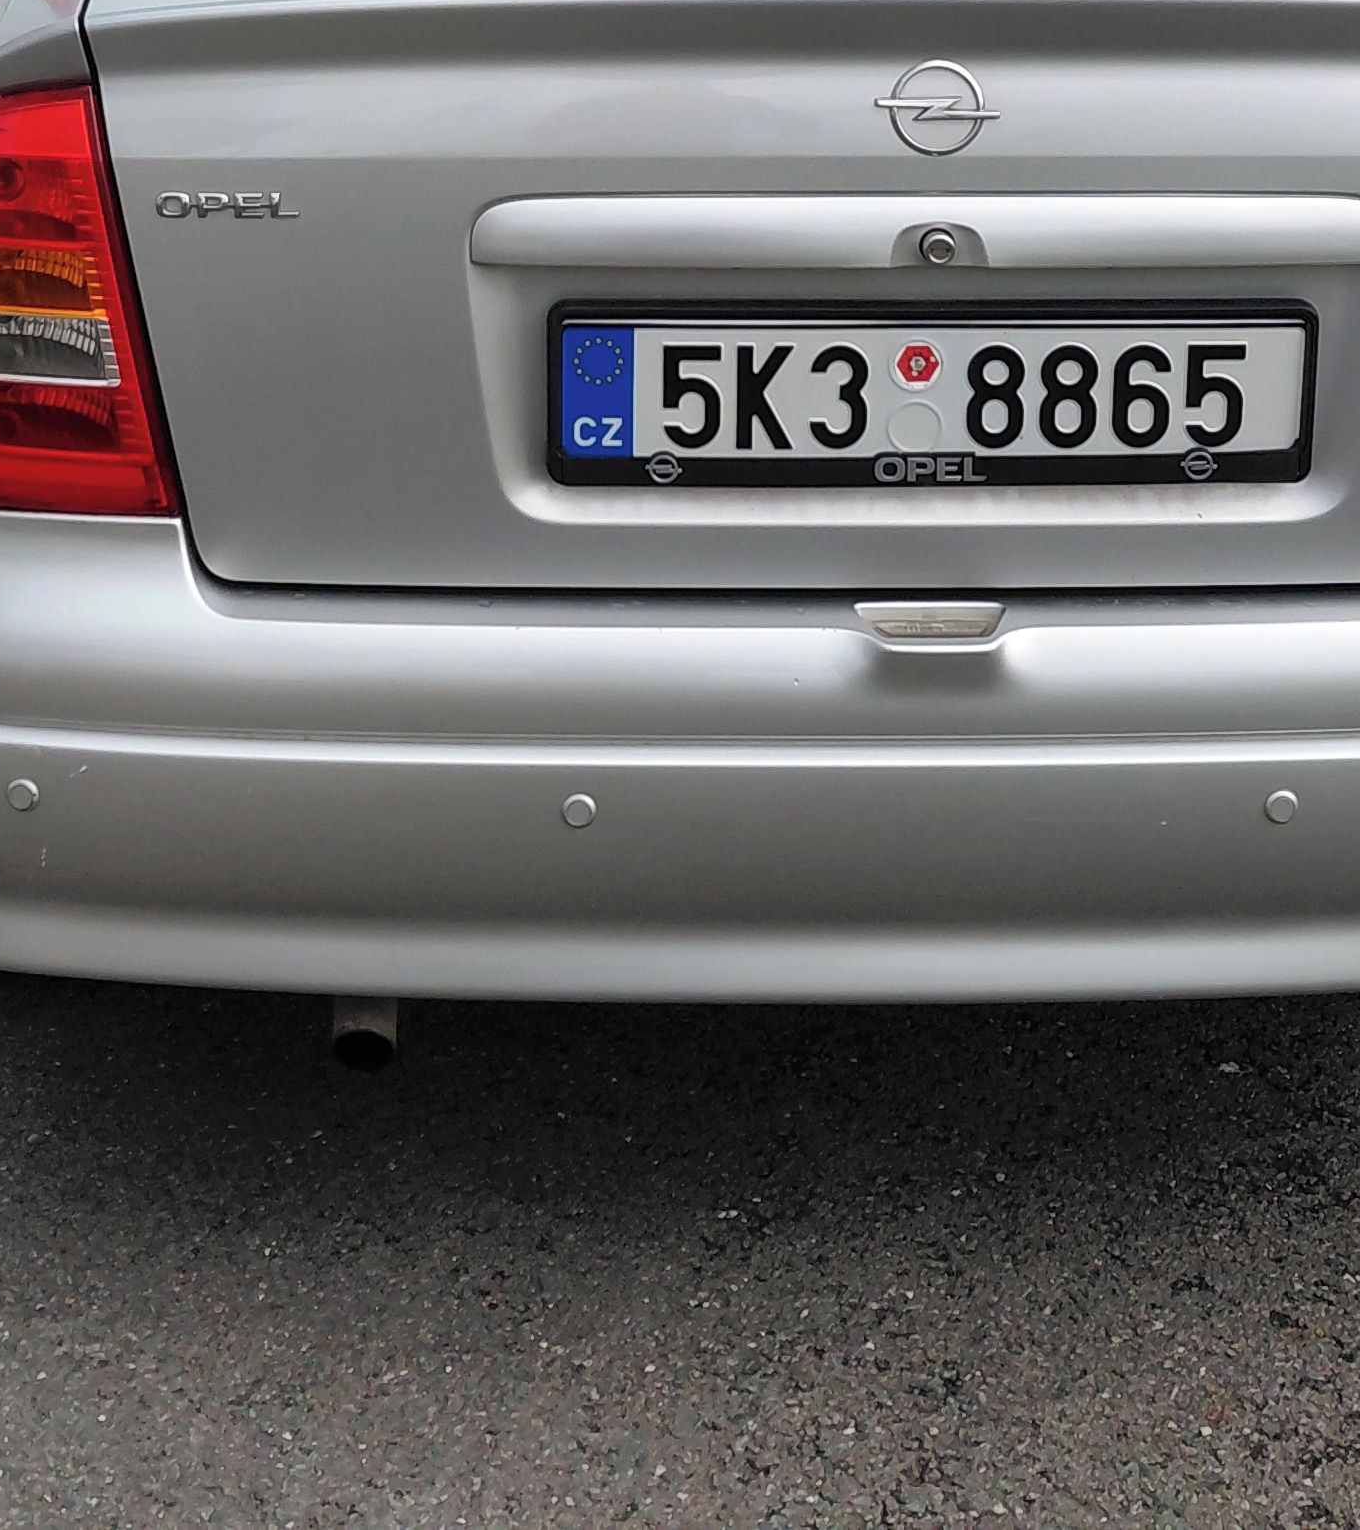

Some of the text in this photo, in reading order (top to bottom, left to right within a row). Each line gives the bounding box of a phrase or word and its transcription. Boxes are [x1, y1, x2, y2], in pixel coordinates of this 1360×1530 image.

[156, 191, 300, 218] OPEL
[662, 344, 1247, 449] 5K3 8865
[572, 416, 623, 448] CZ
[873, 455, 988, 484] OPEL
